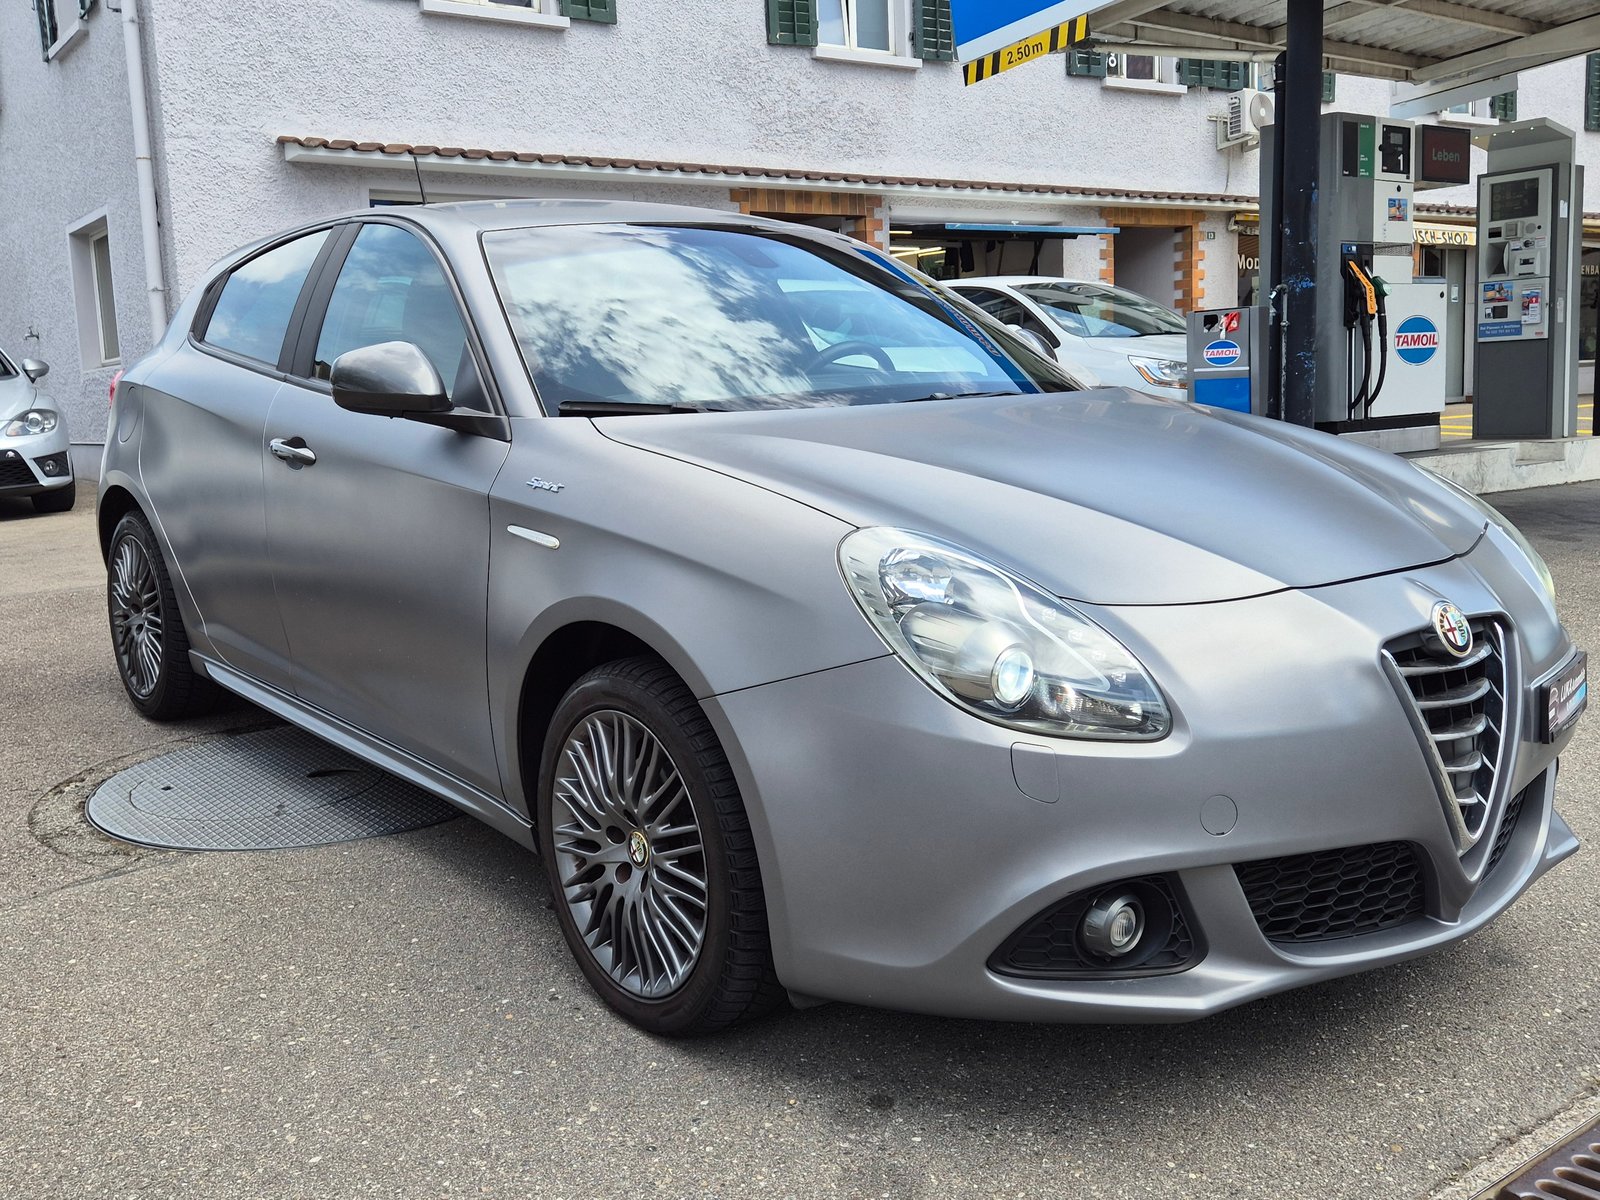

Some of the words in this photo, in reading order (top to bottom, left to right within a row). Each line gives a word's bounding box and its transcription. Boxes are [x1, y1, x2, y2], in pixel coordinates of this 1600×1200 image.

[1397, 153, 1404, 171] 1
[1432, 148, 1460, 162] Leben
[1395, 333, 1438, 347] TAMOIL
[1205, 349, 1239, 357] TAMOIL
